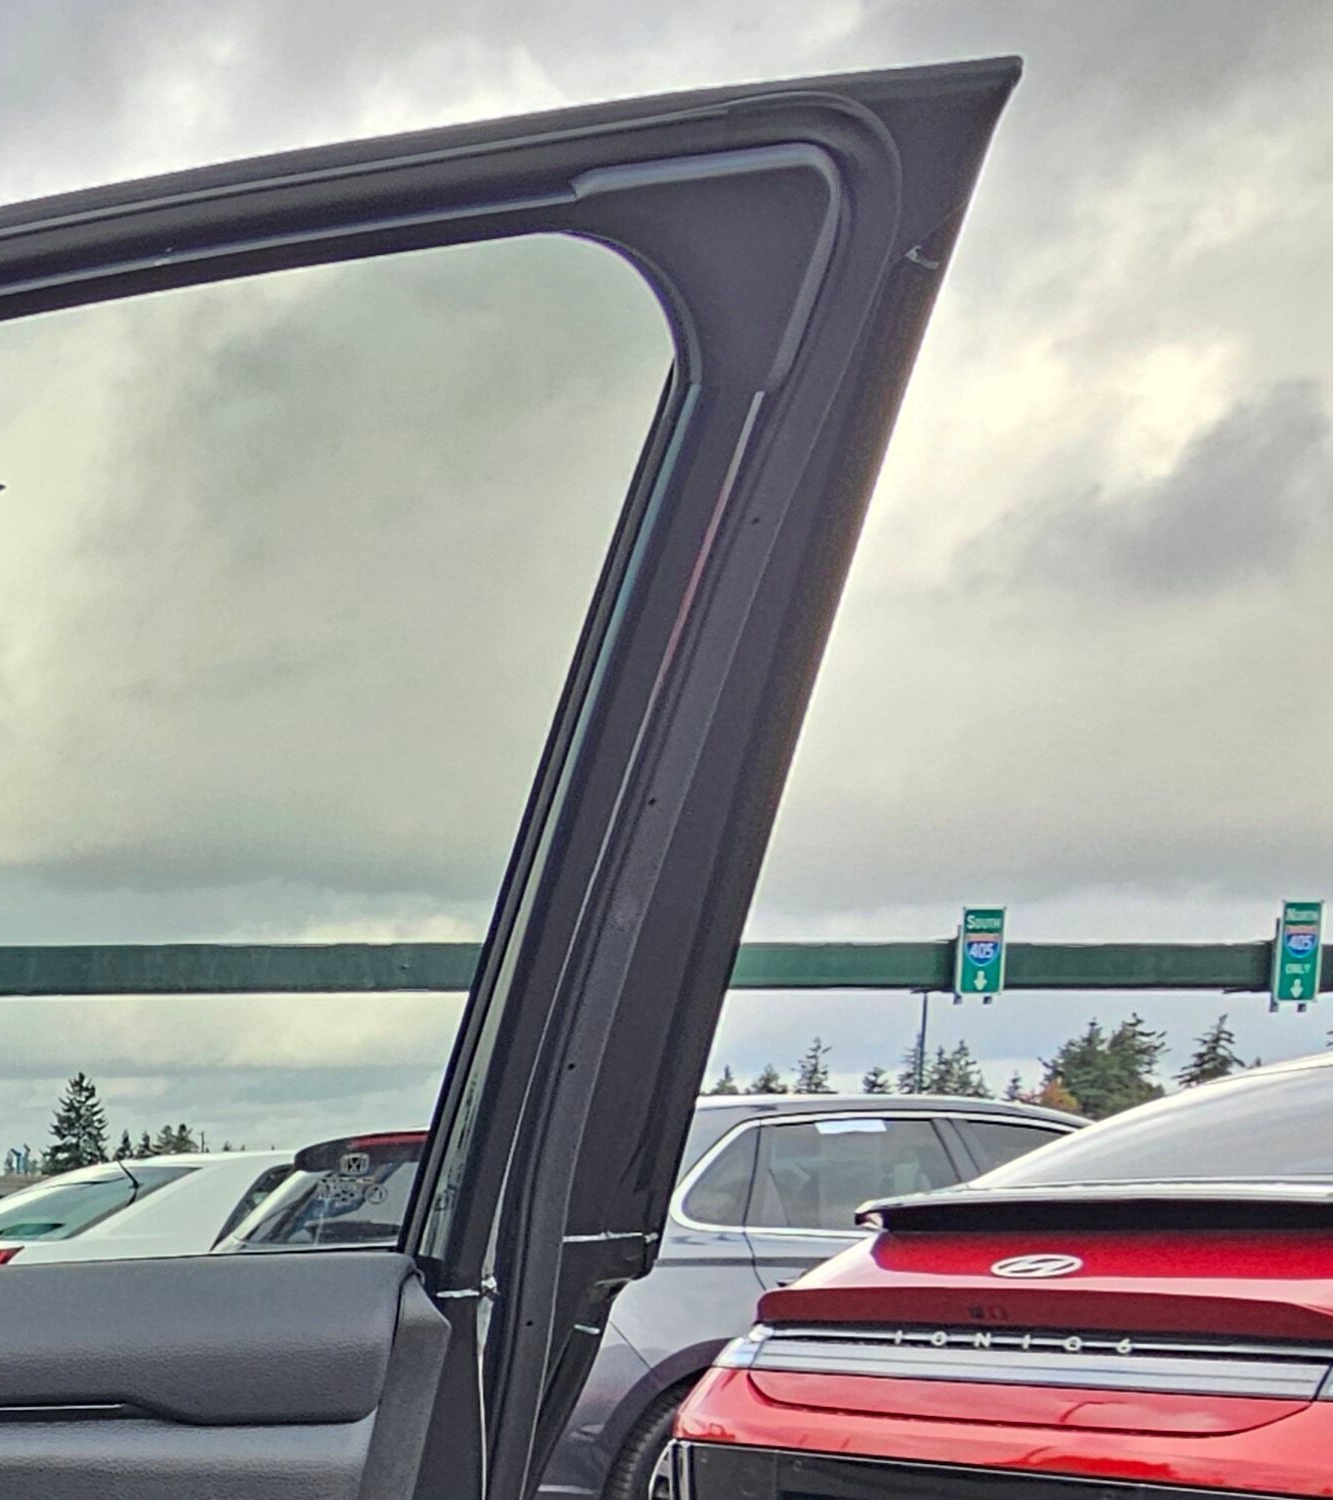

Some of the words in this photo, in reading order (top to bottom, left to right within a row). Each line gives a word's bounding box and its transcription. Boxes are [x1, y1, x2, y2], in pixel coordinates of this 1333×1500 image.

[1289, 934, 1314, 950] 405
[969, 942, 995, 959] 405
[1284, 963, 1311, 975] ONLY
